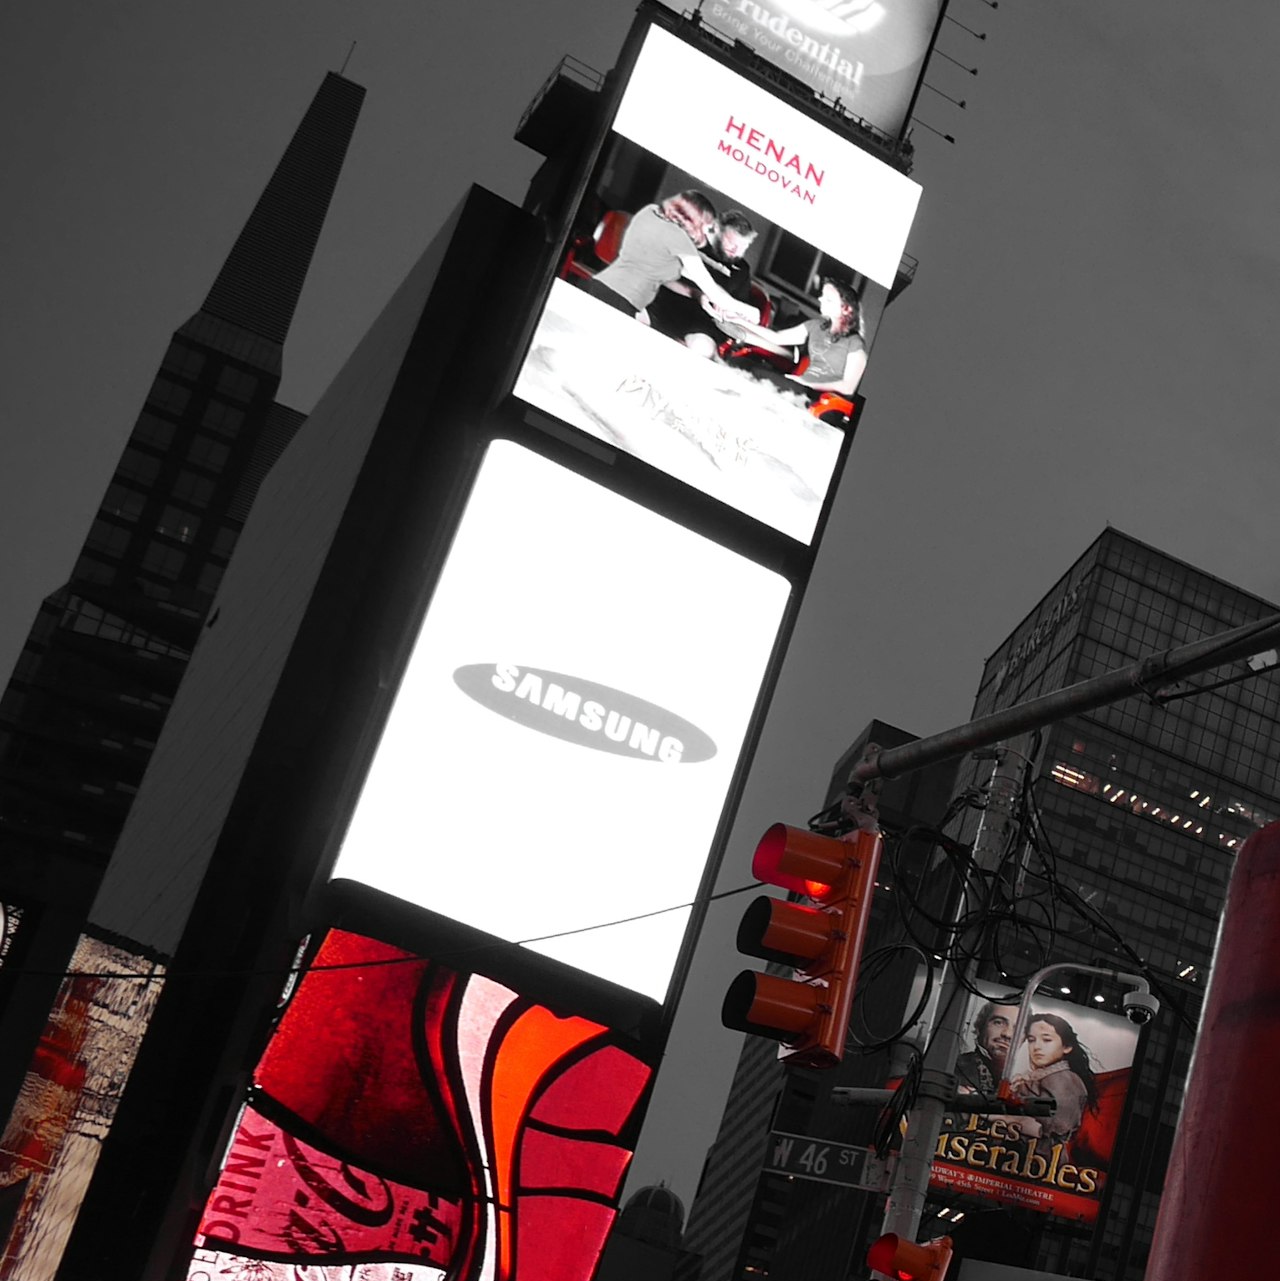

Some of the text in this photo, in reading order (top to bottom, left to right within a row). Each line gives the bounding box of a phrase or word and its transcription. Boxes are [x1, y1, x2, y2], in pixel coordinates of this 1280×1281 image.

[712, 3, 749, 36] Bring
[752, 28, 782, 54] Your
[714, 0, 865, 86] rudential
[717, 140, 816, 204] MOLDOVAN
[725, 116, 825, 187] HENAN
[491, 663, 684, 764] SAMSUNG
[771, 1137, 861, 1175] W 46 ST
[965, 1113, 1022, 1142] Les
[934, 1132, 1098, 1194] isérables
